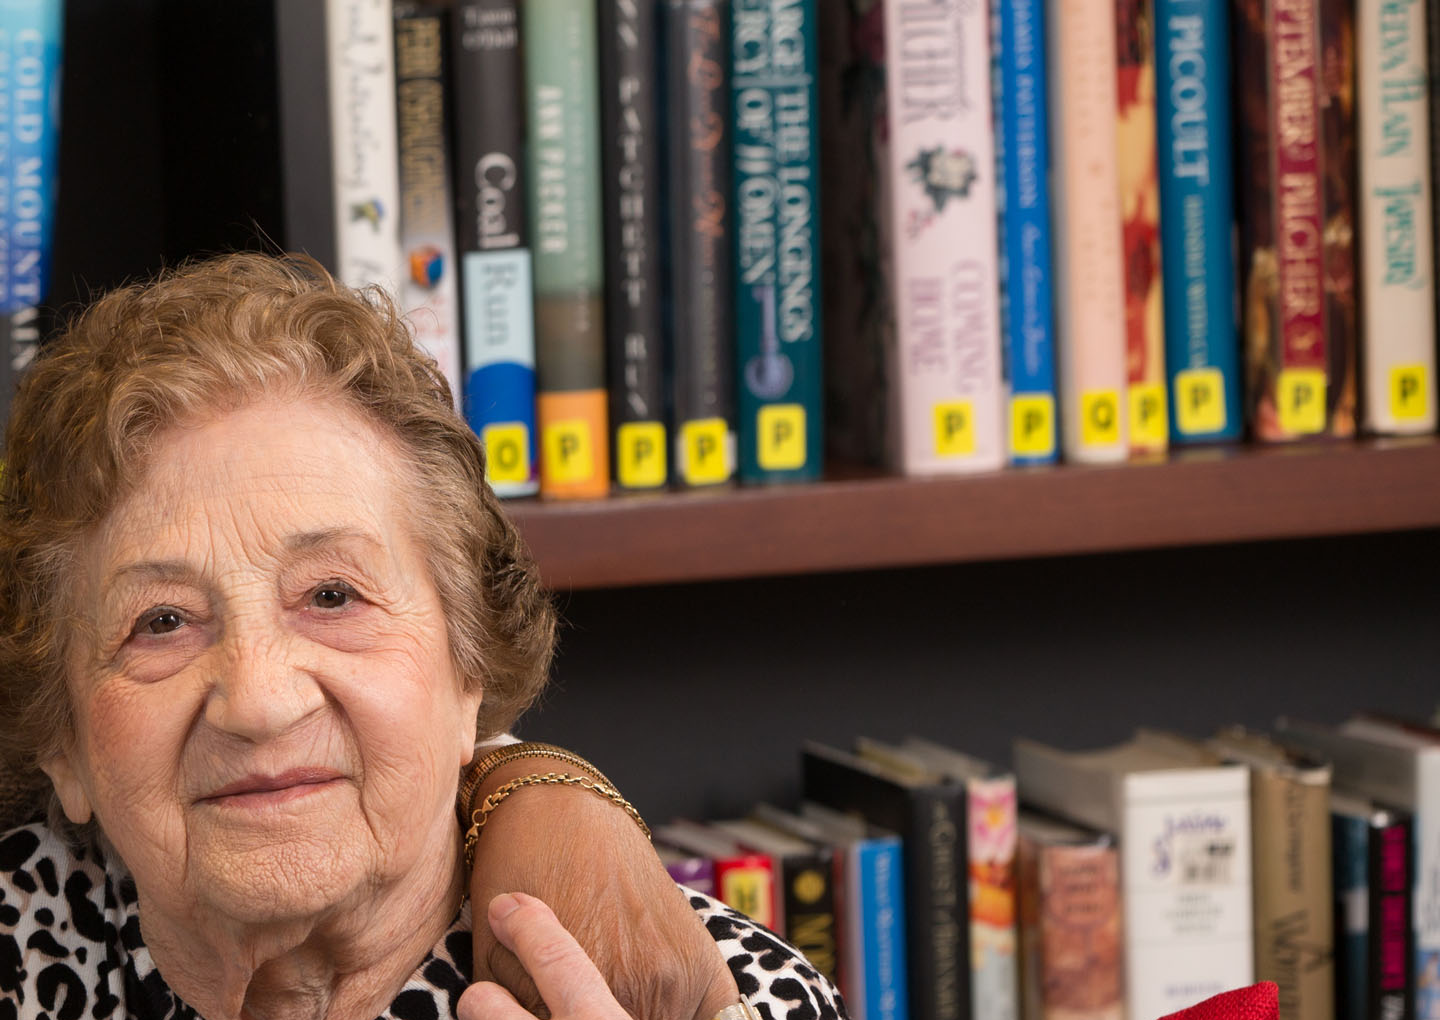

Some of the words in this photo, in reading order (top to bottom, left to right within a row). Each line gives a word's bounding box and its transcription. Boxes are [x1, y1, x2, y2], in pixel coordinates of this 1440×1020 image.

[618, 0, 638, 48] NN
[733, 0, 770, 75] ERCY
[771, 0, 805, 73] ARGE
[1380, 0, 1410, 71] ELVA
[12, 28, 44, 144] COLD
[537, 86, 563, 139] ANN
[737, 88, 773, 142] OF
[1168, 15, 1210, 186] PICOULT
[1276, 0, 1316, 160] PTEMBER
[775, 88, 809, 161] THE
[1014, 74, 1037, 209] PATTERSON
[475, 152, 520, 249] Coal
[538, 148, 568, 253] PACKER
[620, 78, 645, 307] PATCHETT
[738, 143, 775, 285] WOMEN
[9, 157, 44, 369] MOUNTAIN
[778, 166, 814, 342] LONGINGS
[1280, 171, 1320, 319] PILCHER
[482, 262, 518, 347] Run
[908, 276, 946, 376] HOME
[952, 259, 990, 395] COMING
[623, 333, 648, 416] RUN
[1139, 396, 1158, 423] P
[1191, 385, 1210, 413] P
[1293, 384, 1313, 414] P
[1399, 376, 1419, 404] P
[559, 435, 579, 464] P
[634, 437, 653, 466] P
[698, 435, 716, 465] P
[773, 420, 793, 449] P
[944, 411, 966, 442] P
[1023, 409, 1043, 439] P
[1091, 399, 1114, 431] Q
[495, 440, 520, 472] O
